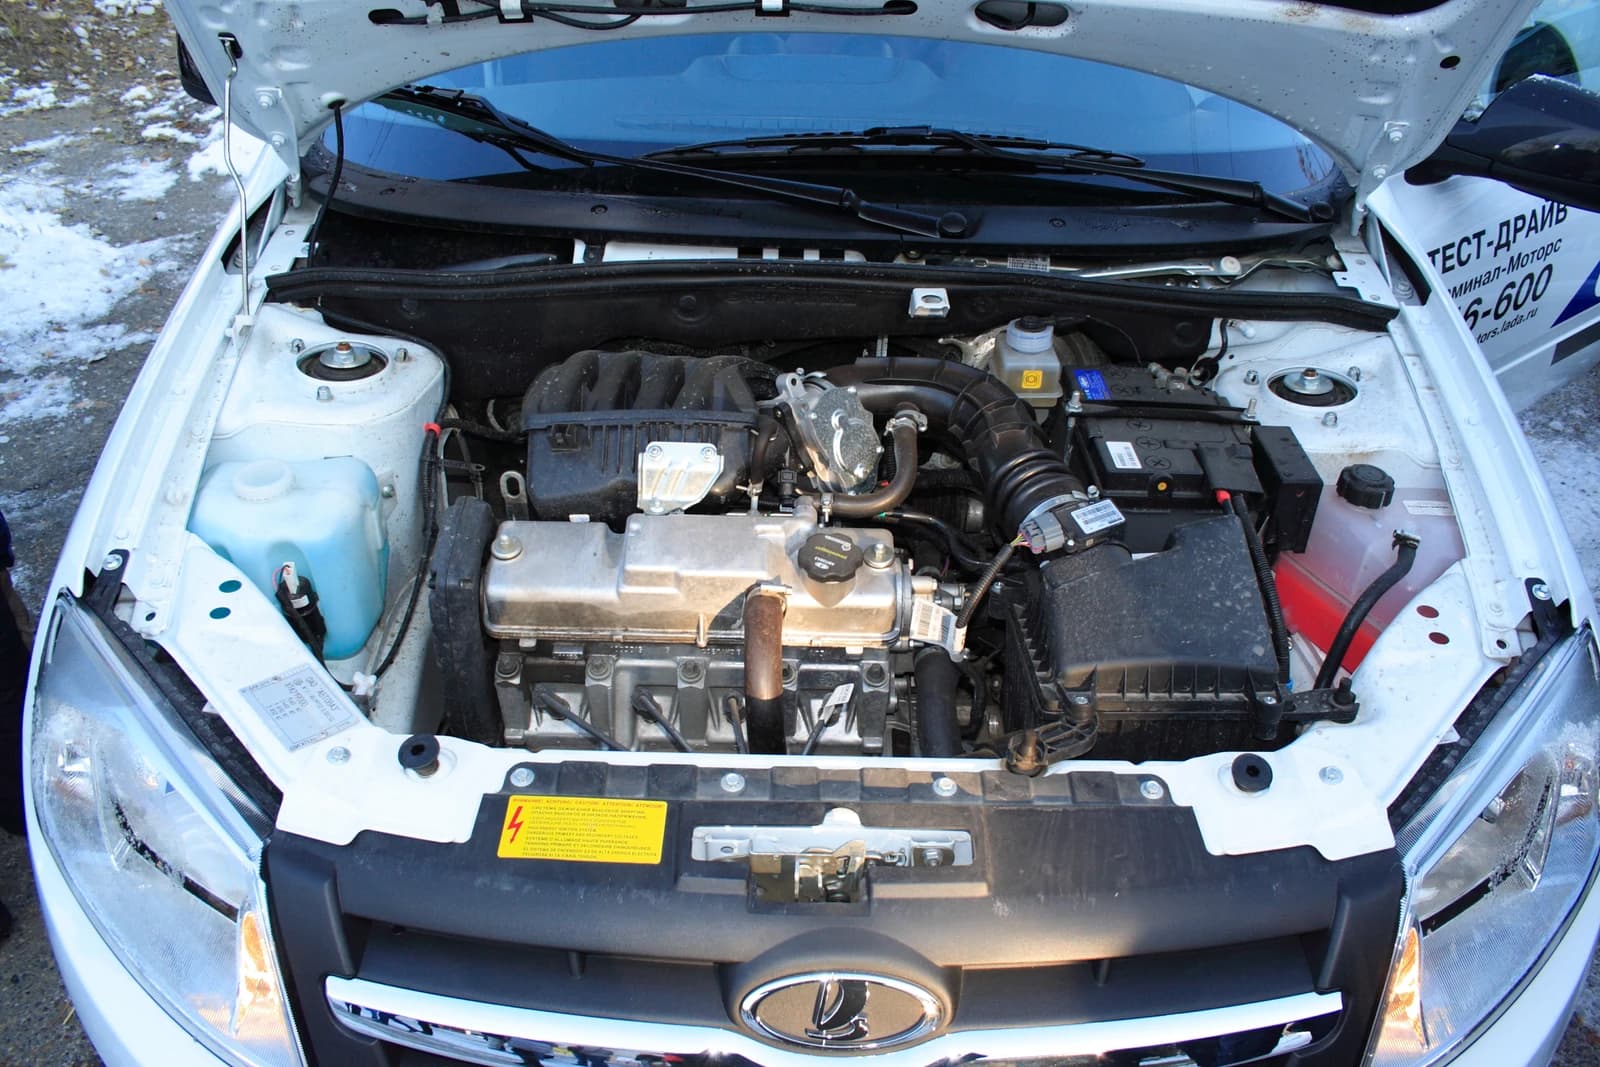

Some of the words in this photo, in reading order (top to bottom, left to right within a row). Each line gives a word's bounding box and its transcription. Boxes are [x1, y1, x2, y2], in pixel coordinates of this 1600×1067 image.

[1427, 199, 1568, 274] ТЕСТ-ДРАЙВ
[1448, 238, 1562, 299] минал-Моторс
[1458, 264, 1553, 331] 6-600
